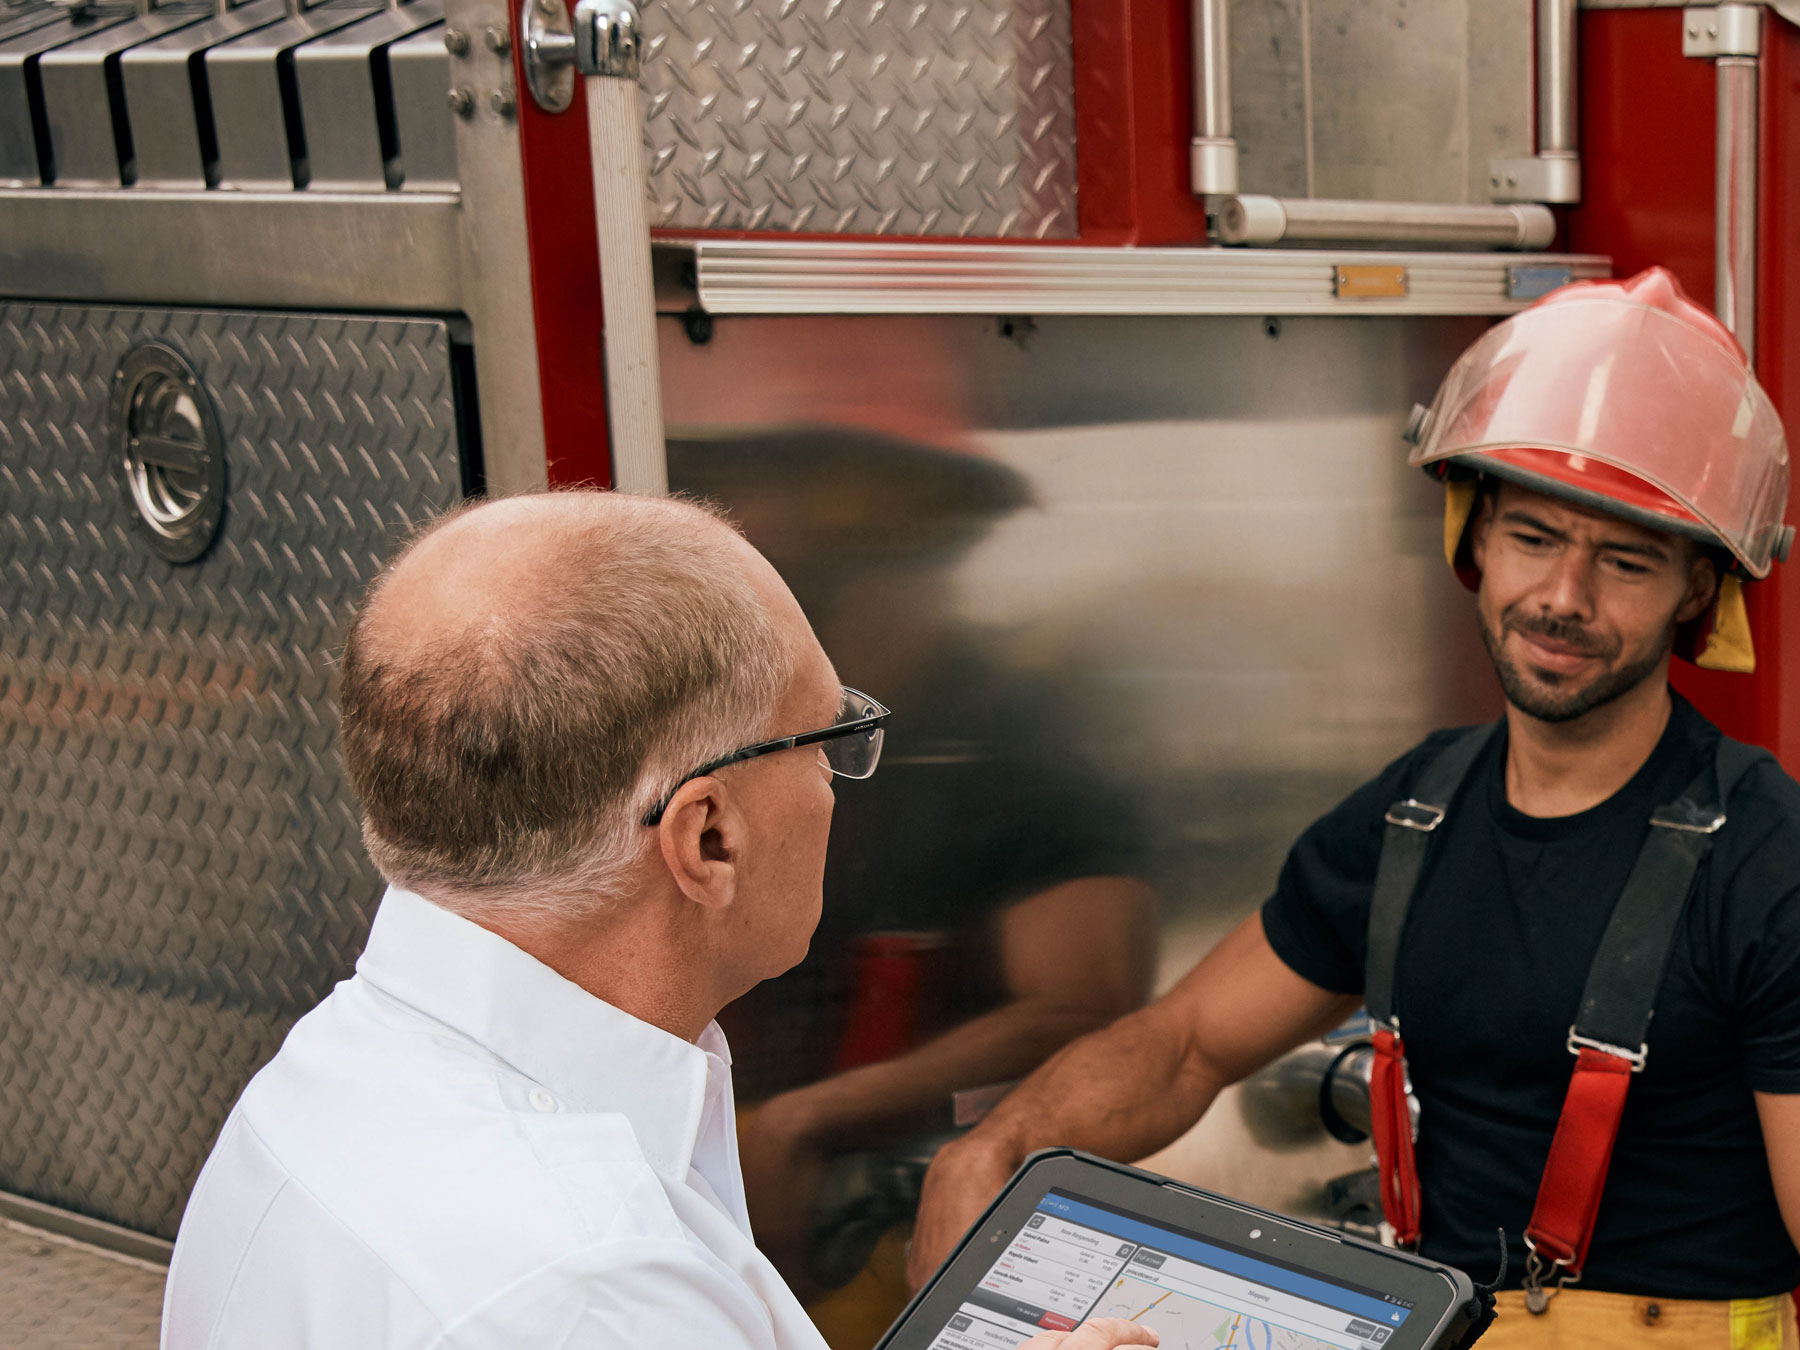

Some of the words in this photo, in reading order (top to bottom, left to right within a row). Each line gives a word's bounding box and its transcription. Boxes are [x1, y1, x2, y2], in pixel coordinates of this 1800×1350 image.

[1023, 1232, 1037, 1240] Gabriel
[1071, 1232, 1101, 1245] Responding
[1146, 1257, 1163, 1265] screen
[1126, 1268, 1154, 1280] princetown
[1248, 1291, 1271, 1302] Mapping
[1349, 1324, 1373, 1335] Navigate
[984, 1331, 1005, 1341] Incident
[1003, 1338, 1019, 1346] Detail
